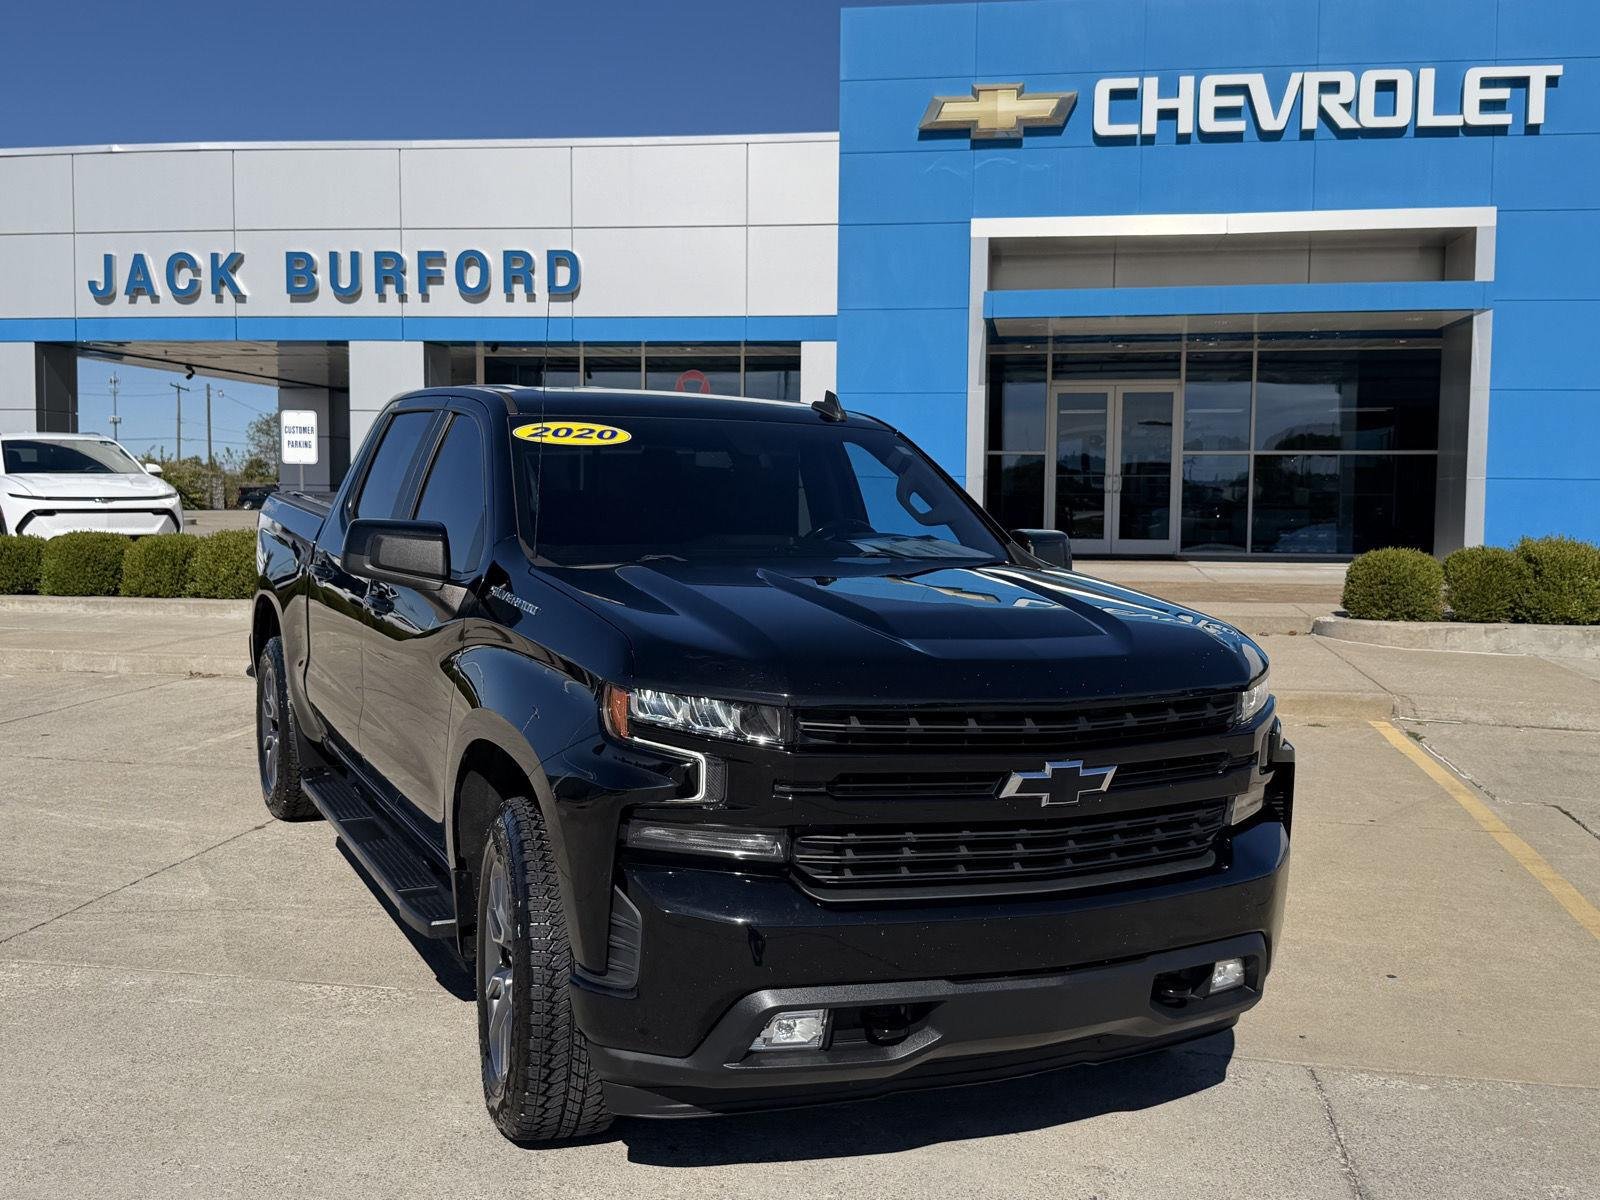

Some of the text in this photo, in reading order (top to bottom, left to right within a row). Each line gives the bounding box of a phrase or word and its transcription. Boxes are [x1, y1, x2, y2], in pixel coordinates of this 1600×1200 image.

[1093, 65, 1563, 135] CHEVROLET
[88, 249, 580, 299] JACK BURFORD
[284, 425, 315, 434] CUSTOMER
[527, 427, 618, 440] 2020
[287, 440, 312, 449] PARKING
